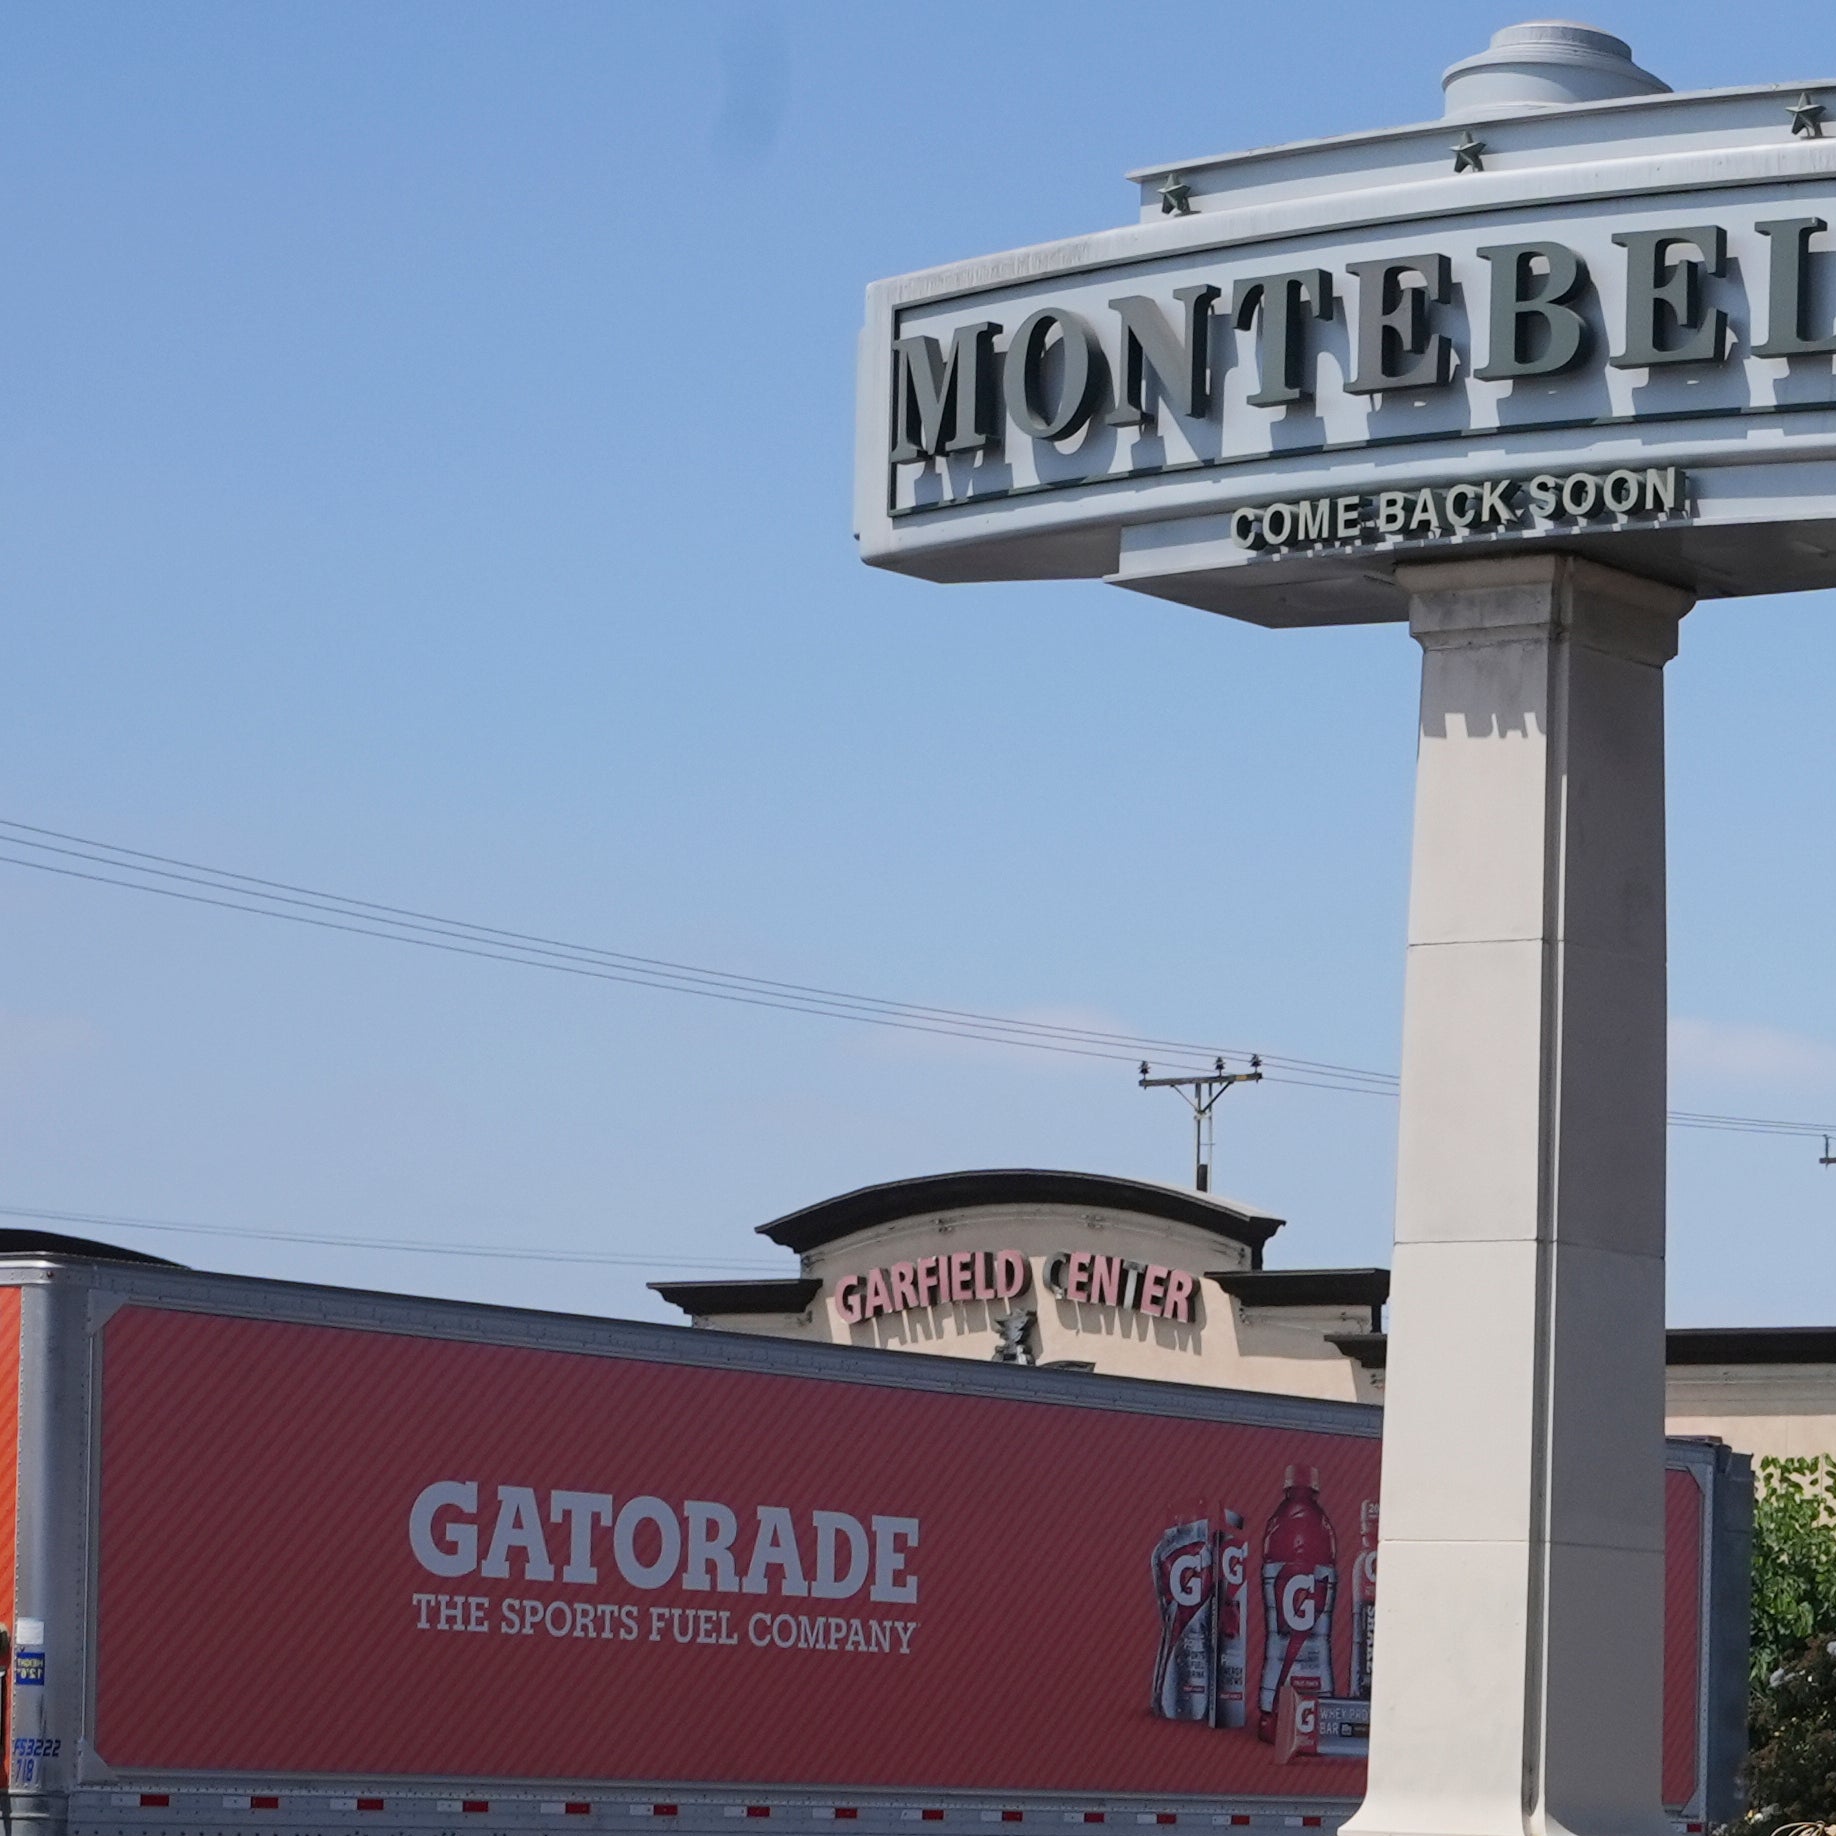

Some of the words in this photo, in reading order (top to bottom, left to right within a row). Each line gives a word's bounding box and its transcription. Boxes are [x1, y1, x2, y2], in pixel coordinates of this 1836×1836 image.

[1230, 495, 1362, 551] COME
[1379, 478, 1520, 533] BACK
[1530, 466, 1679, 519] SOON
[834, 1249, 1031, 1325] GARFIELD
[1043, 1251, 1201, 1323] CENTER
[408, 1480, 920, 1605] GATORADE
[412, 1592, 491, 1633] THE
[500, 1599, 640, 1641] SPORTS
[649, 1606, 739, 1646] FUEL
[748, 1612, 918, 1655] COMPANY
